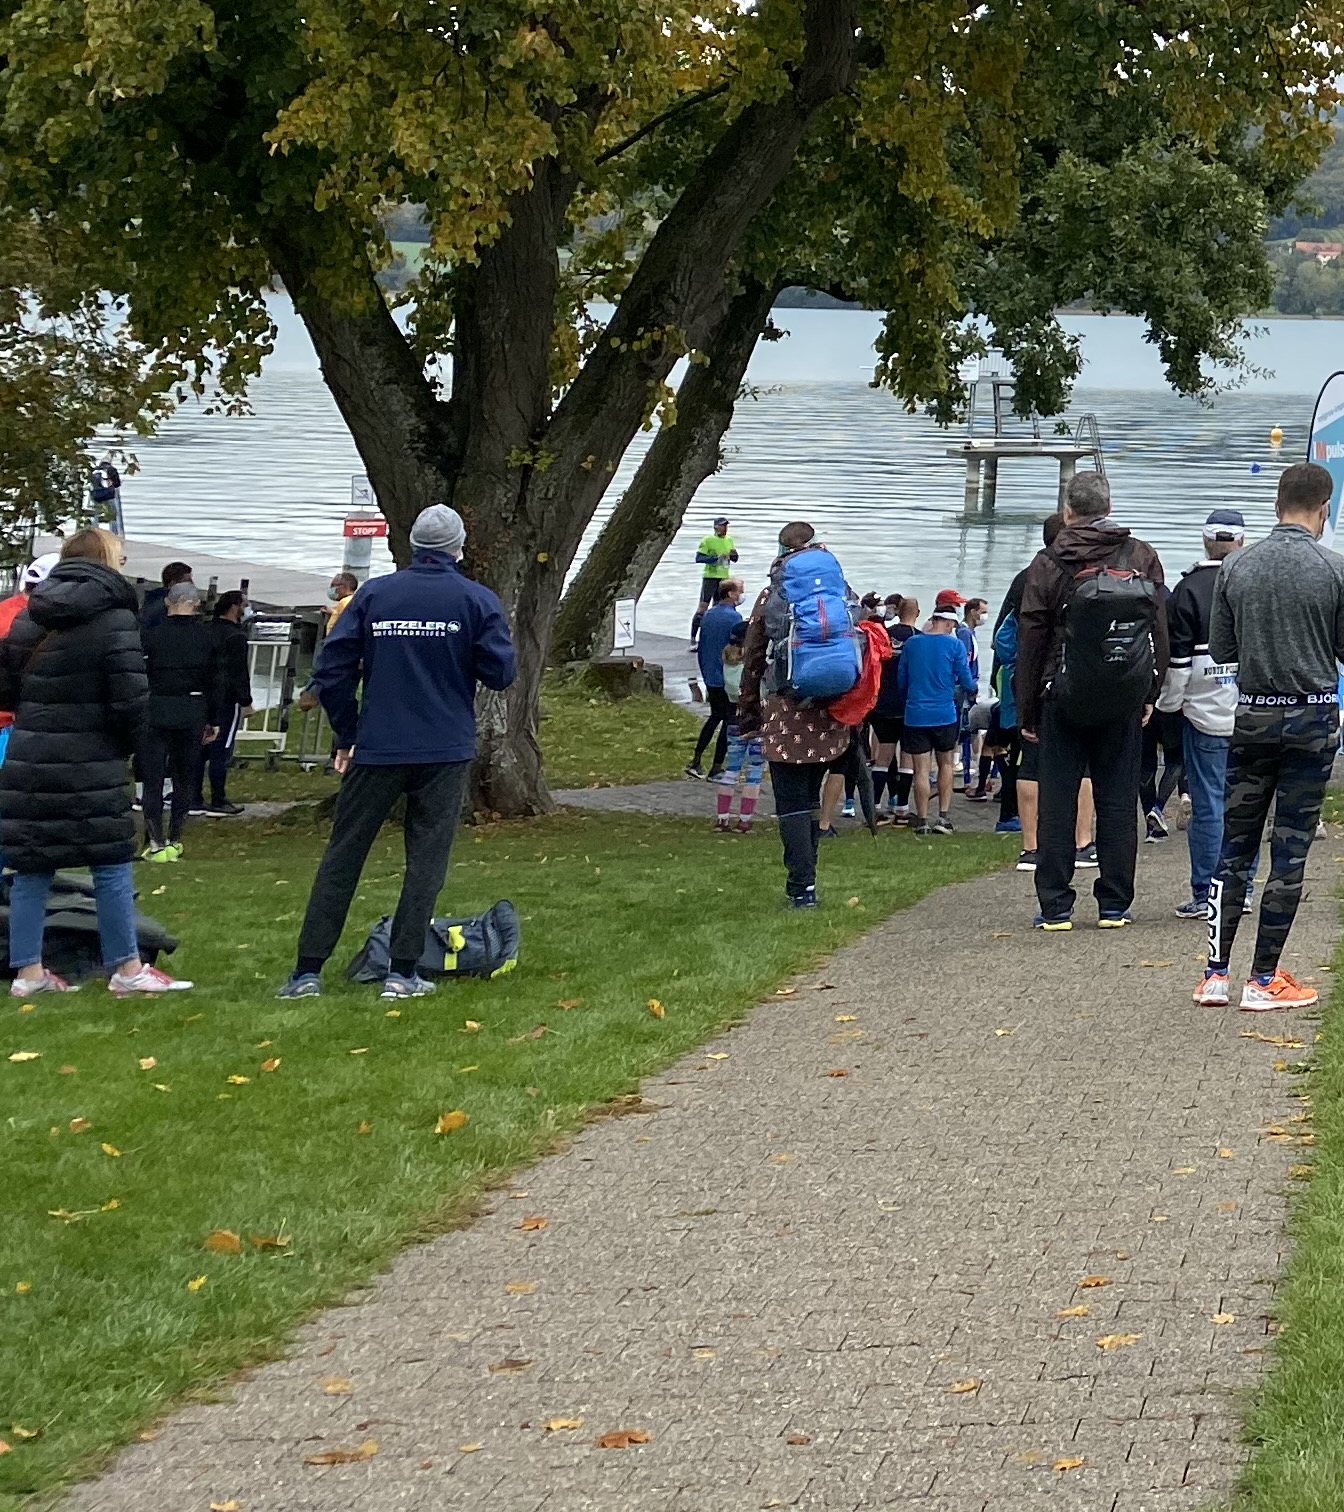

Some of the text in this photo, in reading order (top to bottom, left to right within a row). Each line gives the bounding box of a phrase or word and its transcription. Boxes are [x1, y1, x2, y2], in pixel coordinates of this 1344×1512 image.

[352, 526, 379, 536] STOPP
[371, 620, 447, 631] METZELER
[1255, 695, 1298, 705] BORG
[1307, 691, 1338, 704] BJÖR
